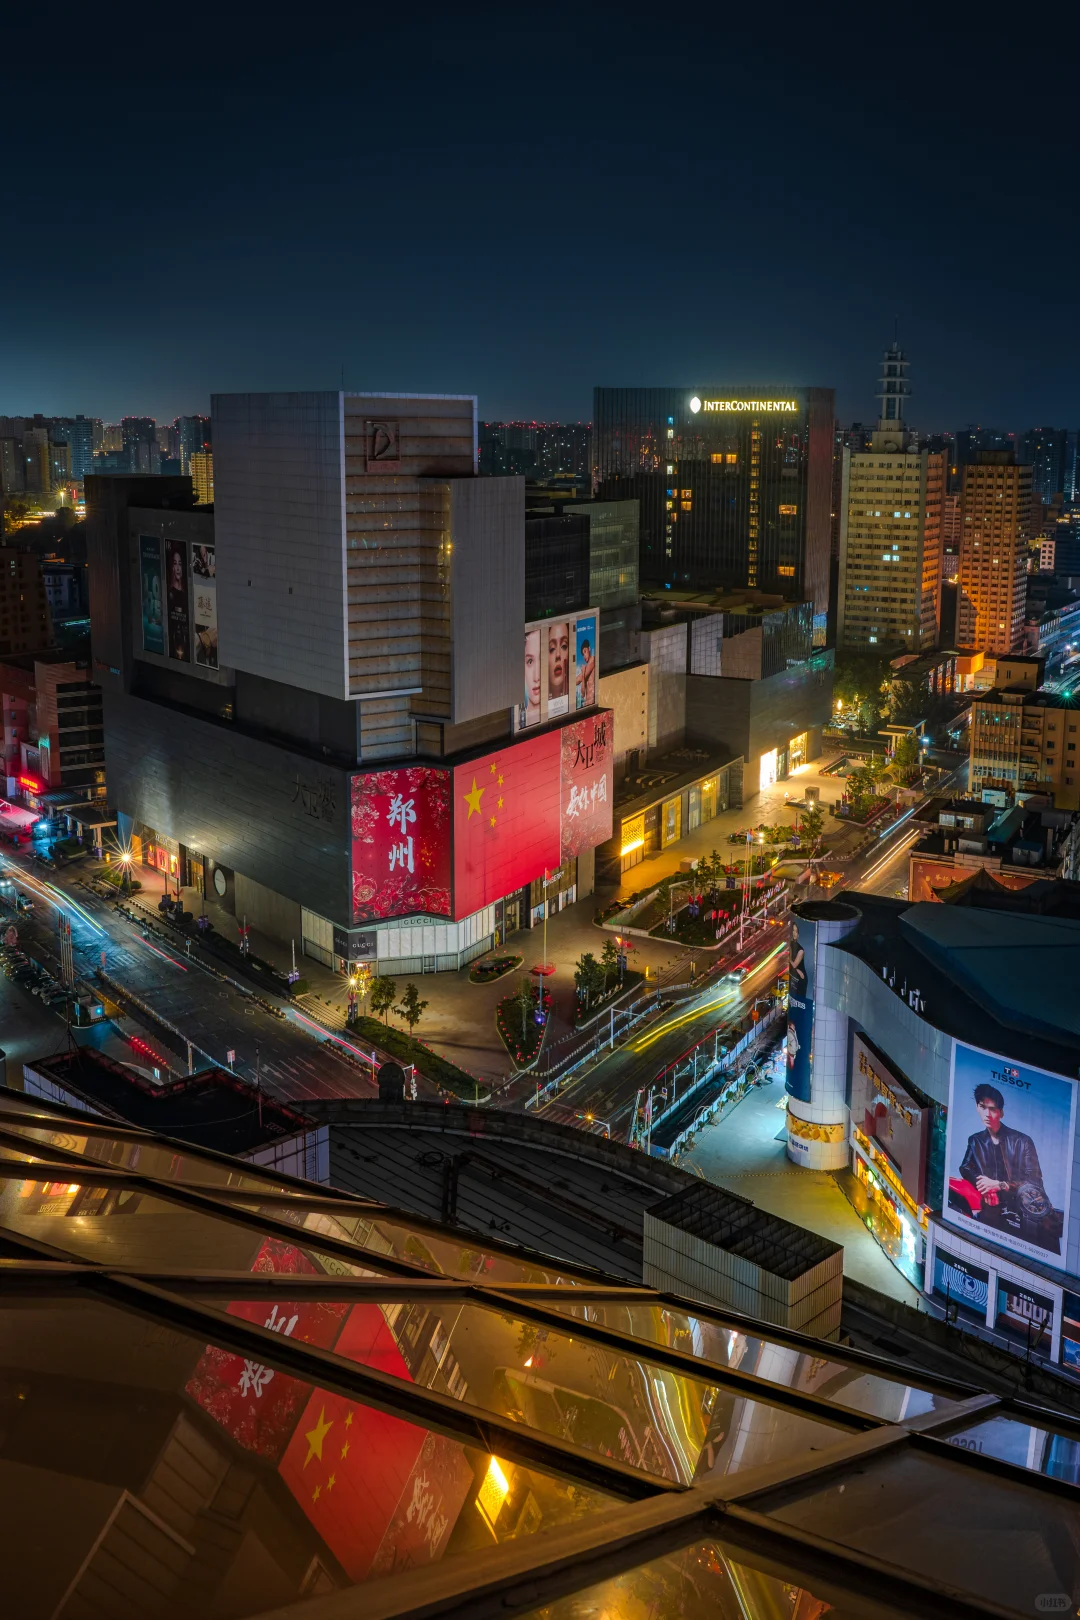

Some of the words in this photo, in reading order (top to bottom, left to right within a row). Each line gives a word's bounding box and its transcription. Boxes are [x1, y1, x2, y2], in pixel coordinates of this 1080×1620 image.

[703, 400, 797, 412] INTERCONTINENTAL
[573, 721, 606, 770] 大卫城
[566, 773, 607, 822] 爱你中国
[386, 793, 417, 874] 郑州
[352, 941, 374, 949] GUCCI
[990, 1070, 1031, 1090] TISSOT
